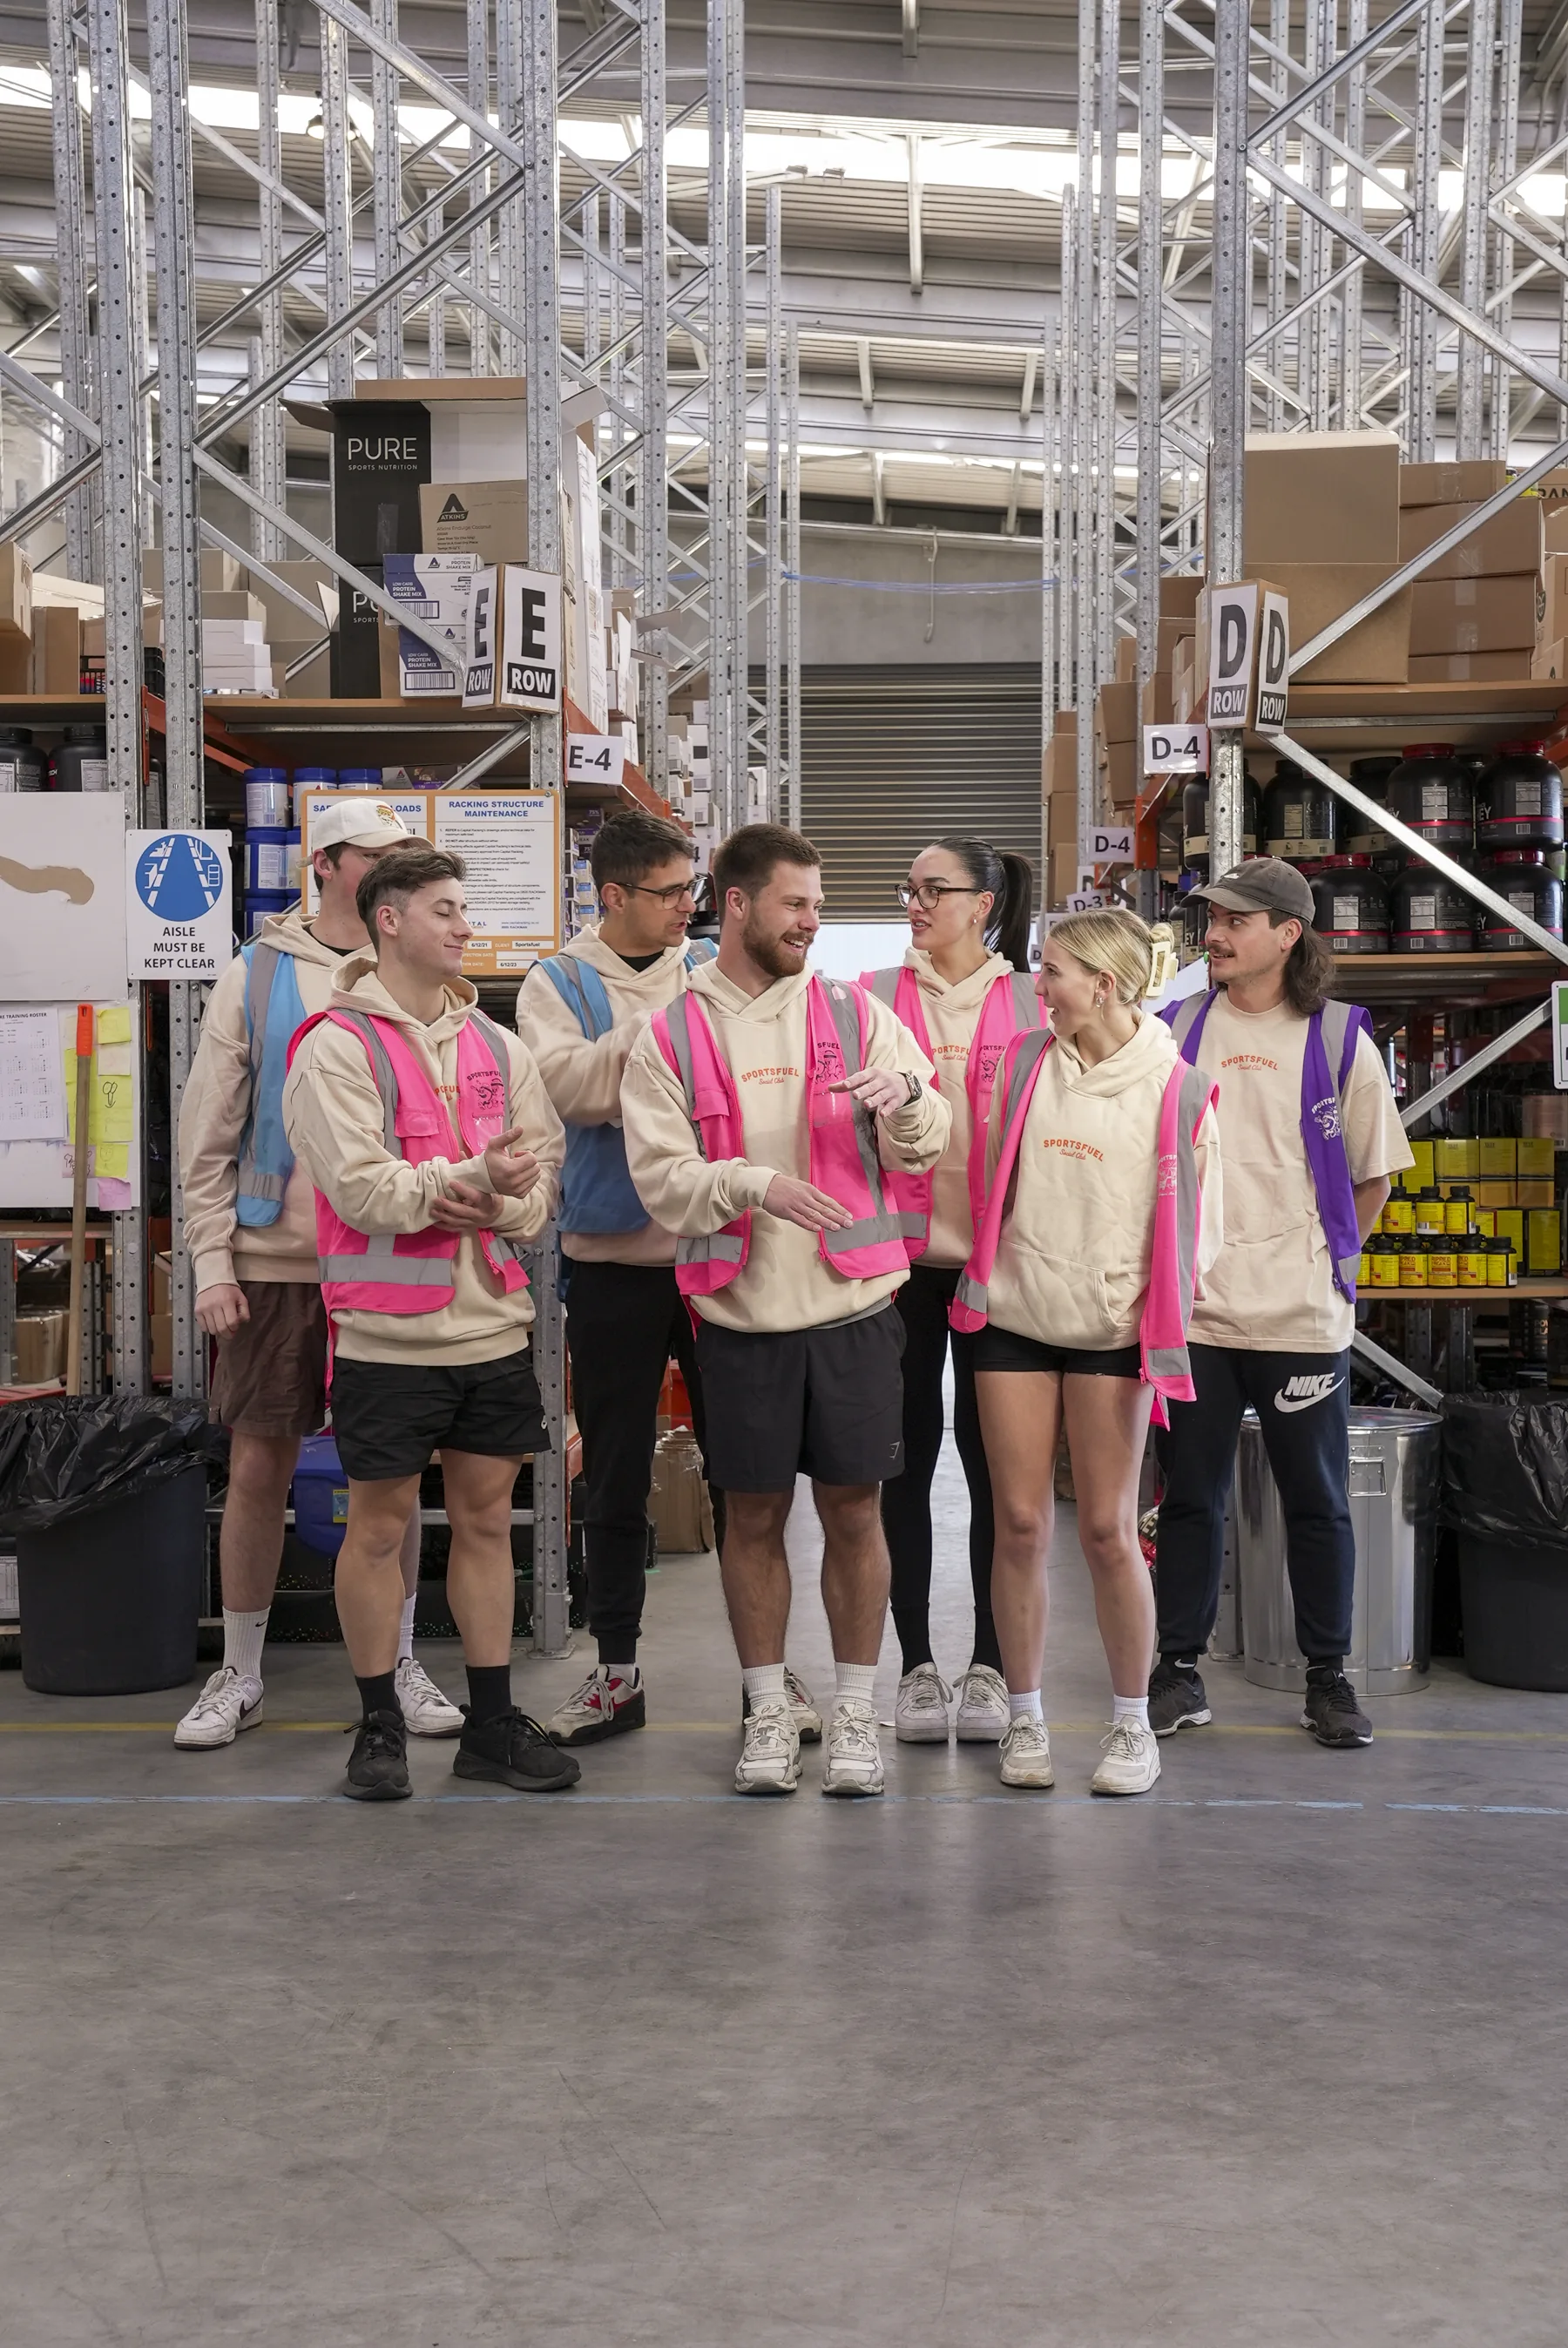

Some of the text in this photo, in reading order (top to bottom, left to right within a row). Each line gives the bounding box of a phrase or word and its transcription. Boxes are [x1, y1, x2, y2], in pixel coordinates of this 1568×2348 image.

[348, 437, 417, 460] PURE
[475, 587, 490, 659] E
[521, 587, 545, 660] E
[1219, 604, 1247, 679] D
[1266, 609, 1286, 685] D
[468, 668, 491, 693] ROW
[511, 668, 551, 694] ROW
[1213, 689, 1245, 714] ROW
[1261, 697, 1285, 721] ROW
[569, 745, 612, 772] E-4
[1152, 735, 1200, 760] D-4
[1095, 836, 1131, 853] D-4
[1074, 896, 1102, 912] D-3
[163, 926, 196, 937] AISLE
[153, 943, 206, 952] MUST BE
[145, 958, 215, 968] KEPT CLEAR
[741, 1067, 799, 1082] SPORTSFUEL
[1221, 1055, 1279, 1071] SPORTSFUEL
[1044, 1139, 1104, 1162] SPORTSFUEL
[1059, 1148, 1087, 1160] Social Club
[1284, 1372, 1335, 1396] NIKE
